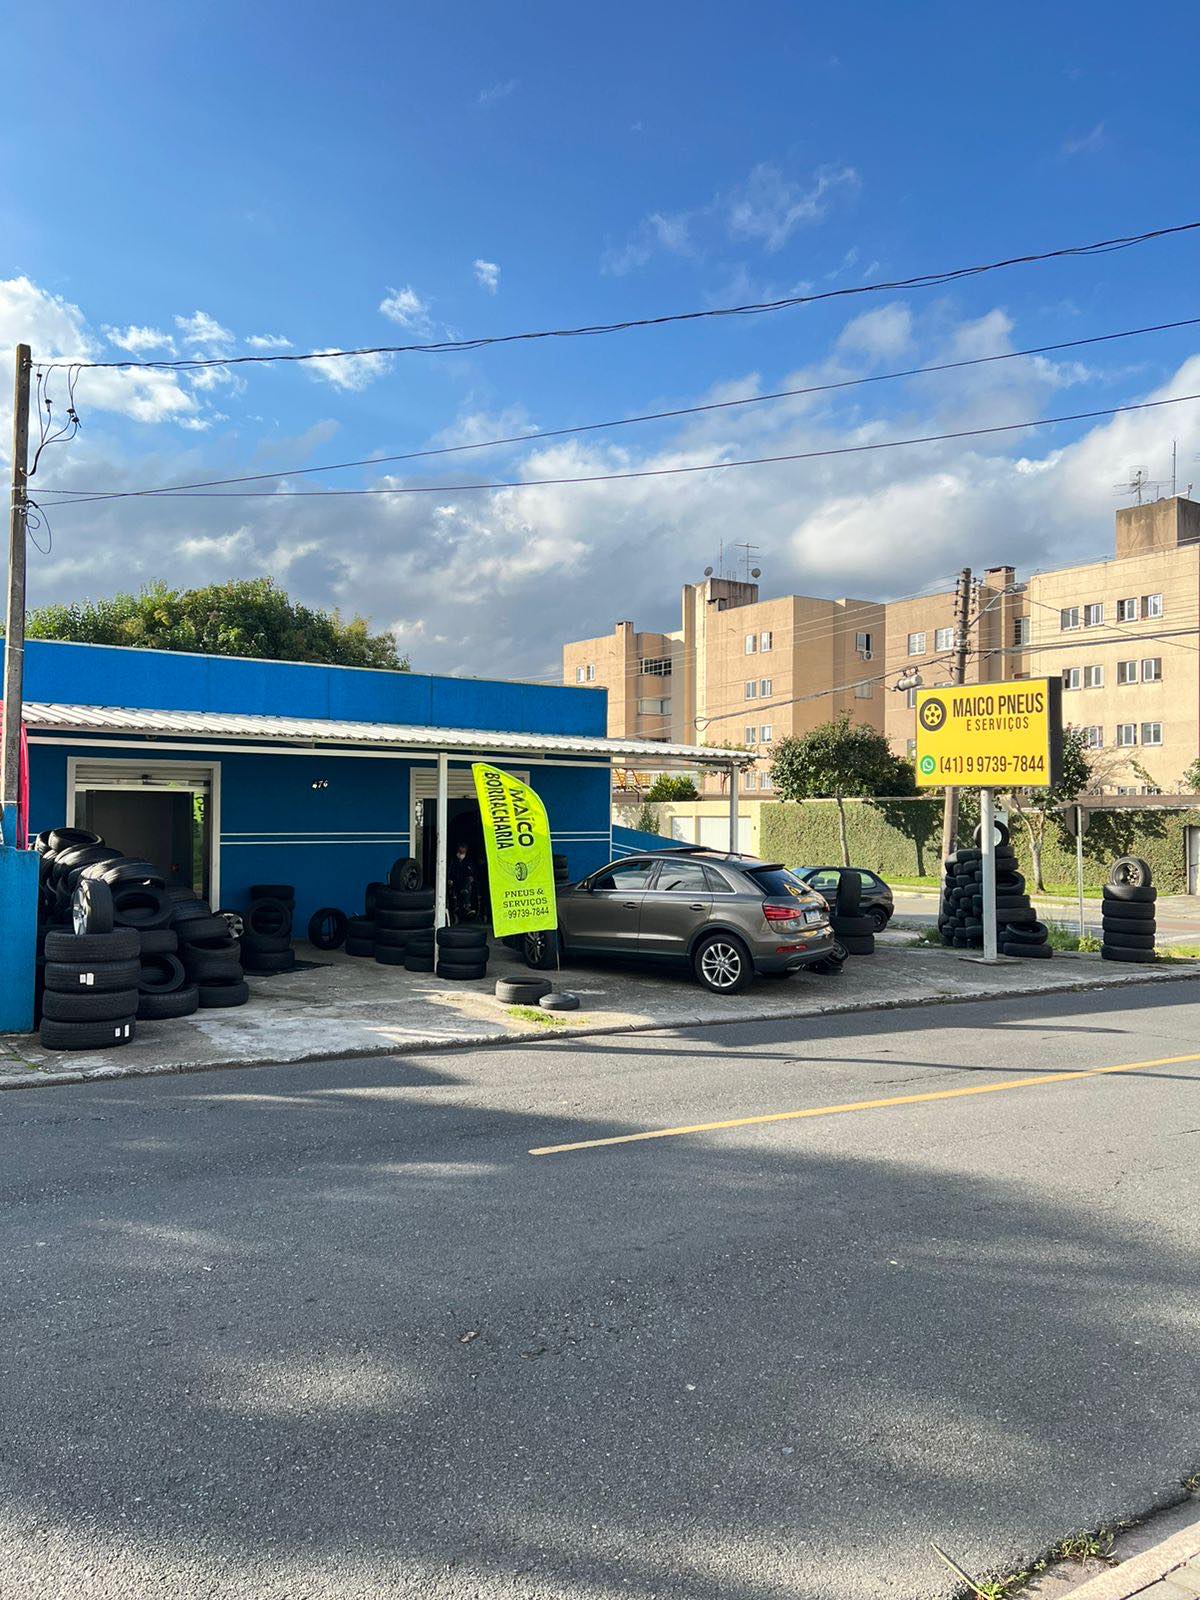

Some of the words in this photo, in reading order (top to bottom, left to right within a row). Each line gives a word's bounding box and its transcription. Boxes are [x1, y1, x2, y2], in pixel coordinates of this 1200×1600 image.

[952, 695, 994, 718] MAICO
[998, 692, 1044, 715] PNEUS
[966, 719, 972, 731] E
[975, 716, 1029, 732] SERVIÇOS
[940, 756, 963, 773] (41)
[966, 756, 974, 772] 9
[977, 755, 1045, 773] 9739-7844
[484, 772, 514, 850] BORRACHARIA
[504, 888, 535, 898] PNEUS
[536, 887, 544, 895] &
[507, 906, 549, 919] 99739-7844
